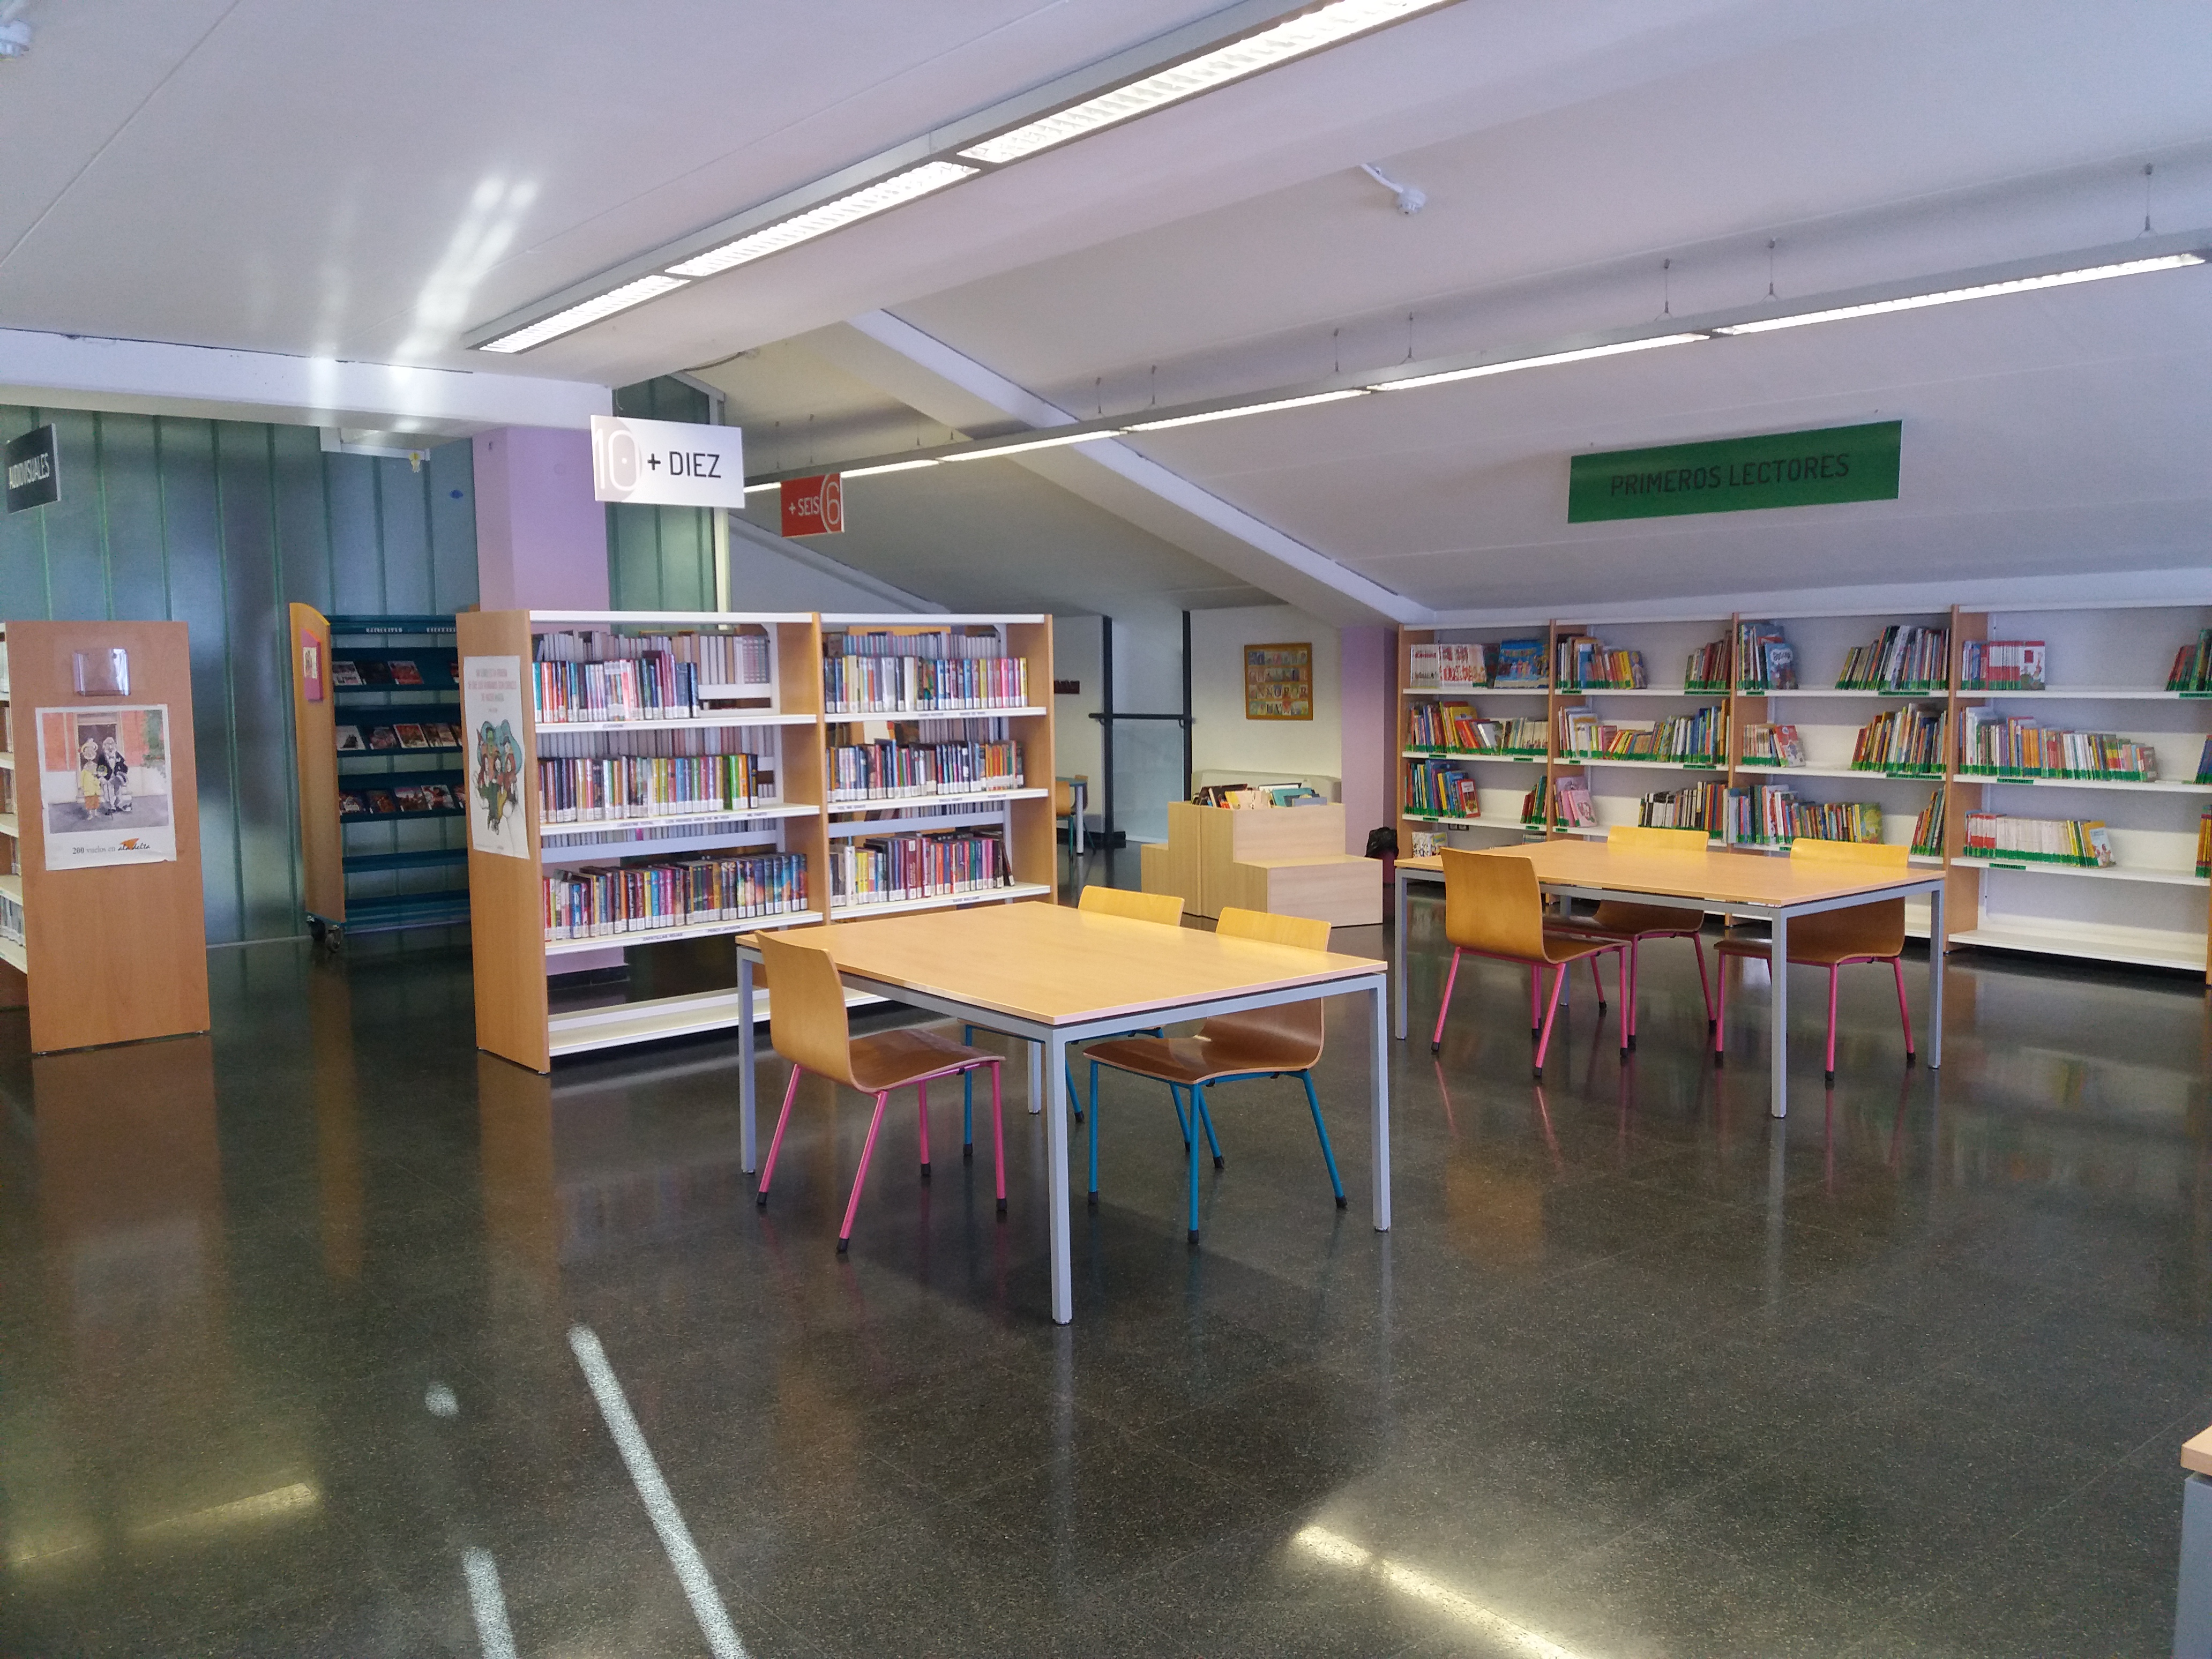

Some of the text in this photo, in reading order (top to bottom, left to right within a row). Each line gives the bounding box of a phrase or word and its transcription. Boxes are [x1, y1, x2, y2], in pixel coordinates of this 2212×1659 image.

[669, 451, 722, 479] DIEZ
[1610, 453, 1850, 497] PRIMEROS LECTORES
[797, 496, 820, 517] SEIS
[86, 845, 106, 853] vuelos
